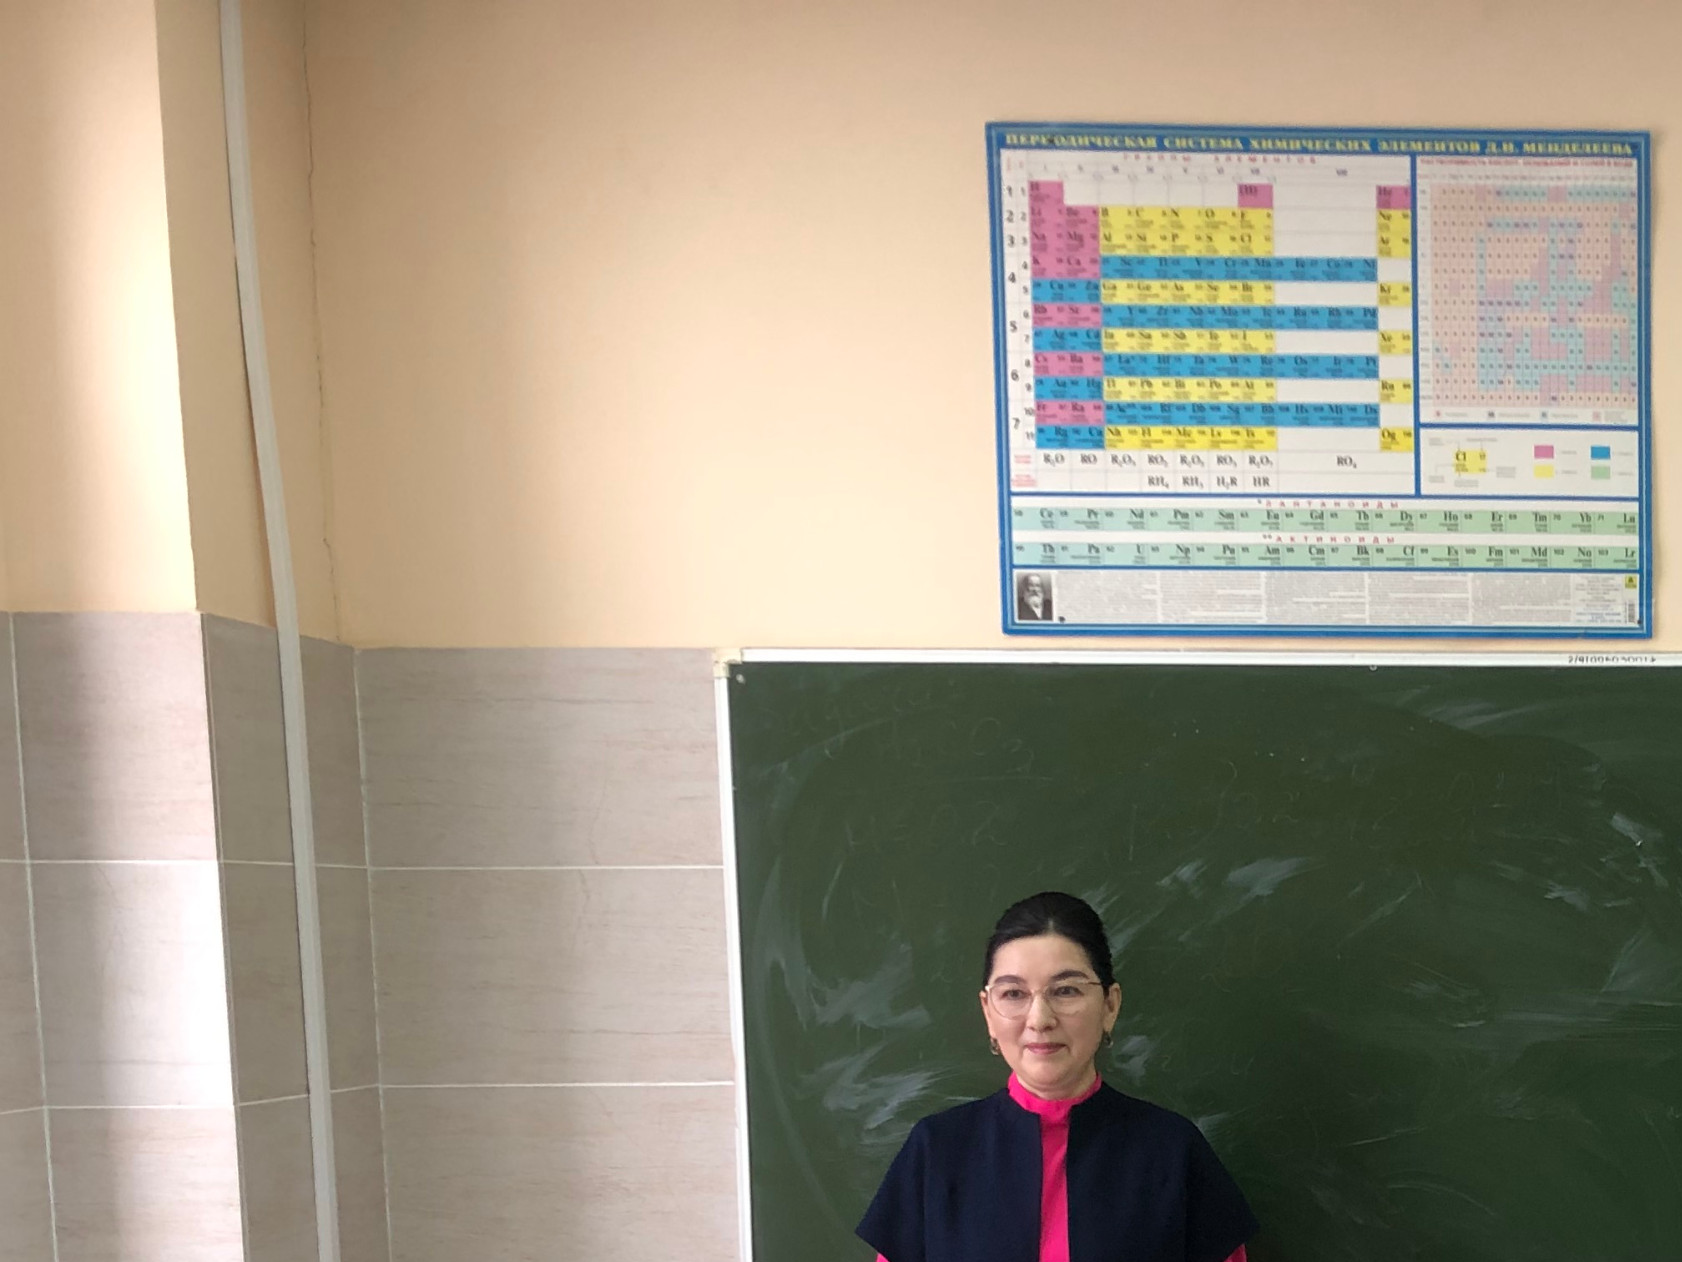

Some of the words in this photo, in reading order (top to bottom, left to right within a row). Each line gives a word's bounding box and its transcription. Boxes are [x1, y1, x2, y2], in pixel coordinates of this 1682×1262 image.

[1162, 136, 1244, 150] СИСТЕМА
[1249, 137, 1372, 152] ХИМИЧЕСКИХ
[1377, 140, 1481, 153] ЭЛЕМЕНТОВ
[1522, 142, 1633, 155] МЕНДЕЛЕЕВА
